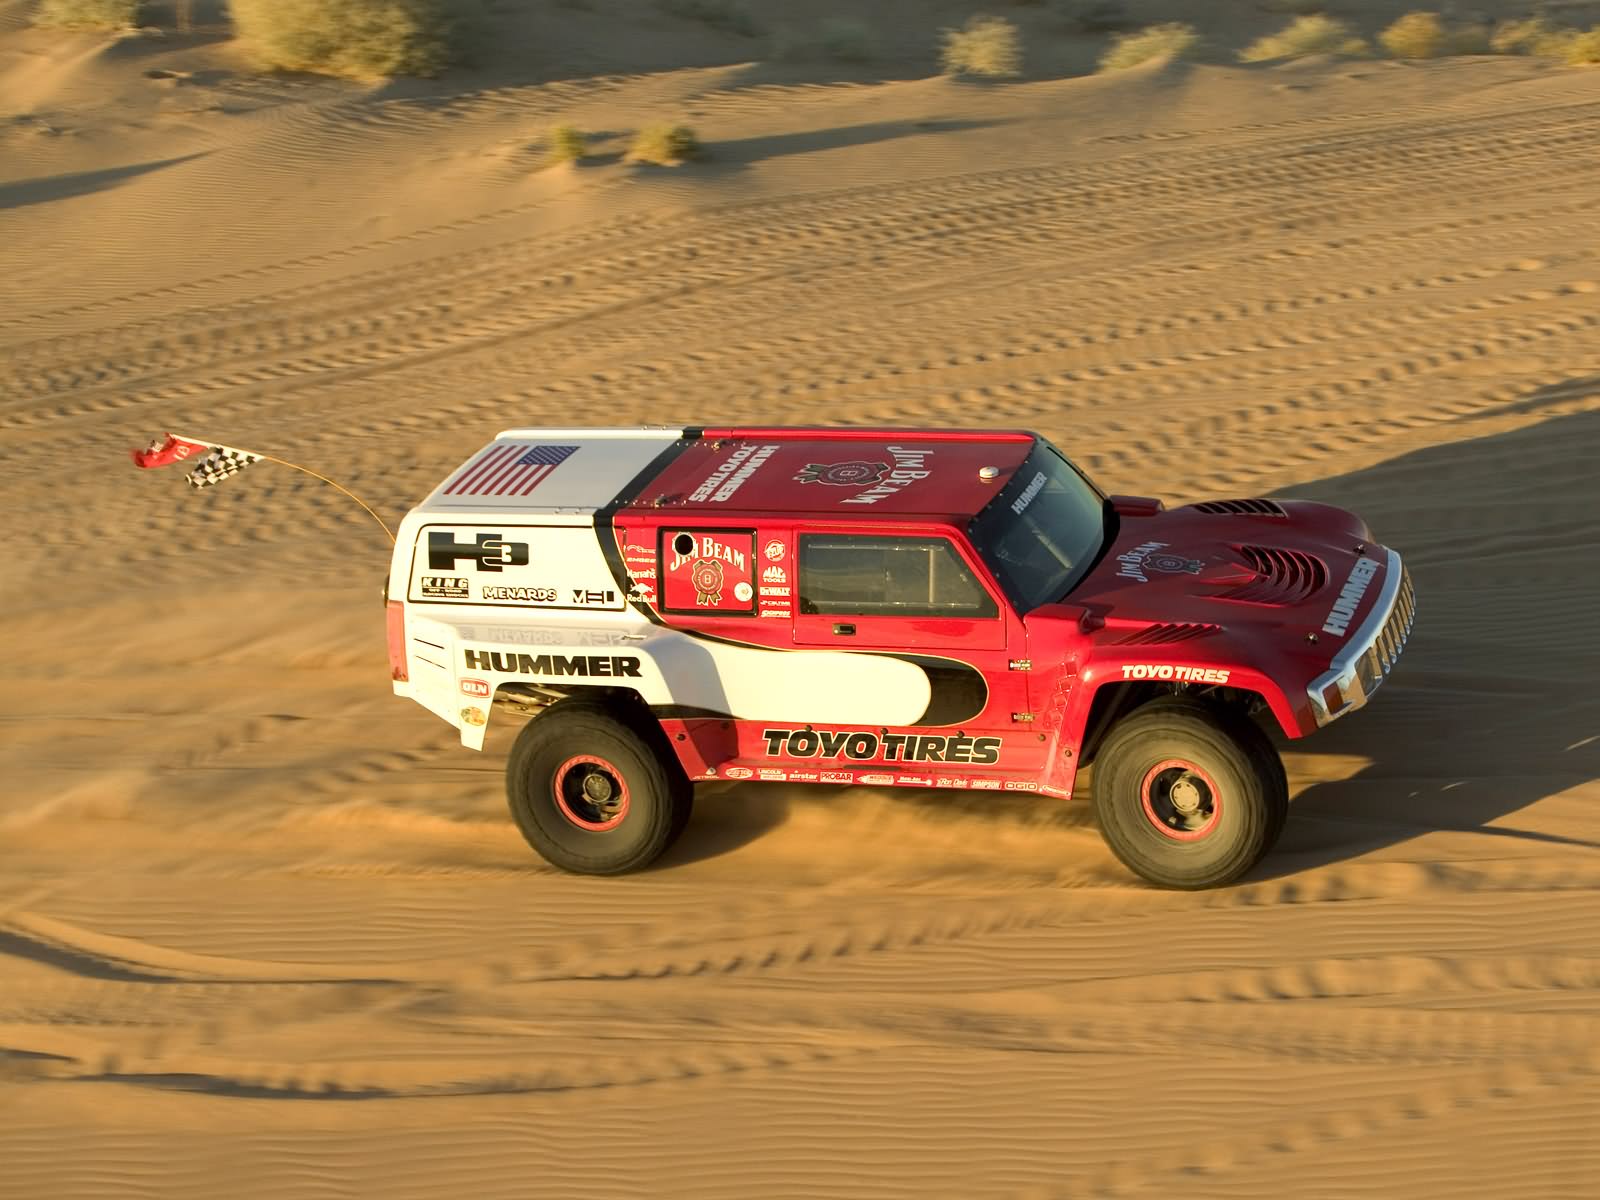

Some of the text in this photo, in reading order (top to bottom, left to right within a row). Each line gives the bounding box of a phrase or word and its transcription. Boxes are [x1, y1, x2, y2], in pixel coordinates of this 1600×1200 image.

[688, 446, 758, 503] TOYO TIRES
[709, 446, 780, 502] HUMMER
[839, 446, 934, 504] JIM BEAM
[1011, 471, 1048, 515] HUMMER
[428, 531, 529, 572] H3
[702, 537, 745, 573] BEAM
[1115, 541, 1171, 582] JIM BEAM
[422, 577, 469, 588] KING
[482, 586, 557, 601] MENARDS
[627, 594, 656, 603] Red Bull
[1321, 557, 1380, 637] HUMMER
[464, 649, 643, 678] HUMMER
[1121, 664, 1231, 684] TOYO TIRES
[763, 728, 1003, 765] TOYO TIRES
[790, 770, 818, 780] airstar
[821, 772, 852, 781] PROBAR
[971, 779, 1001, 789] SIMPSON
[1005, 781, 1038, 791] OGIO
